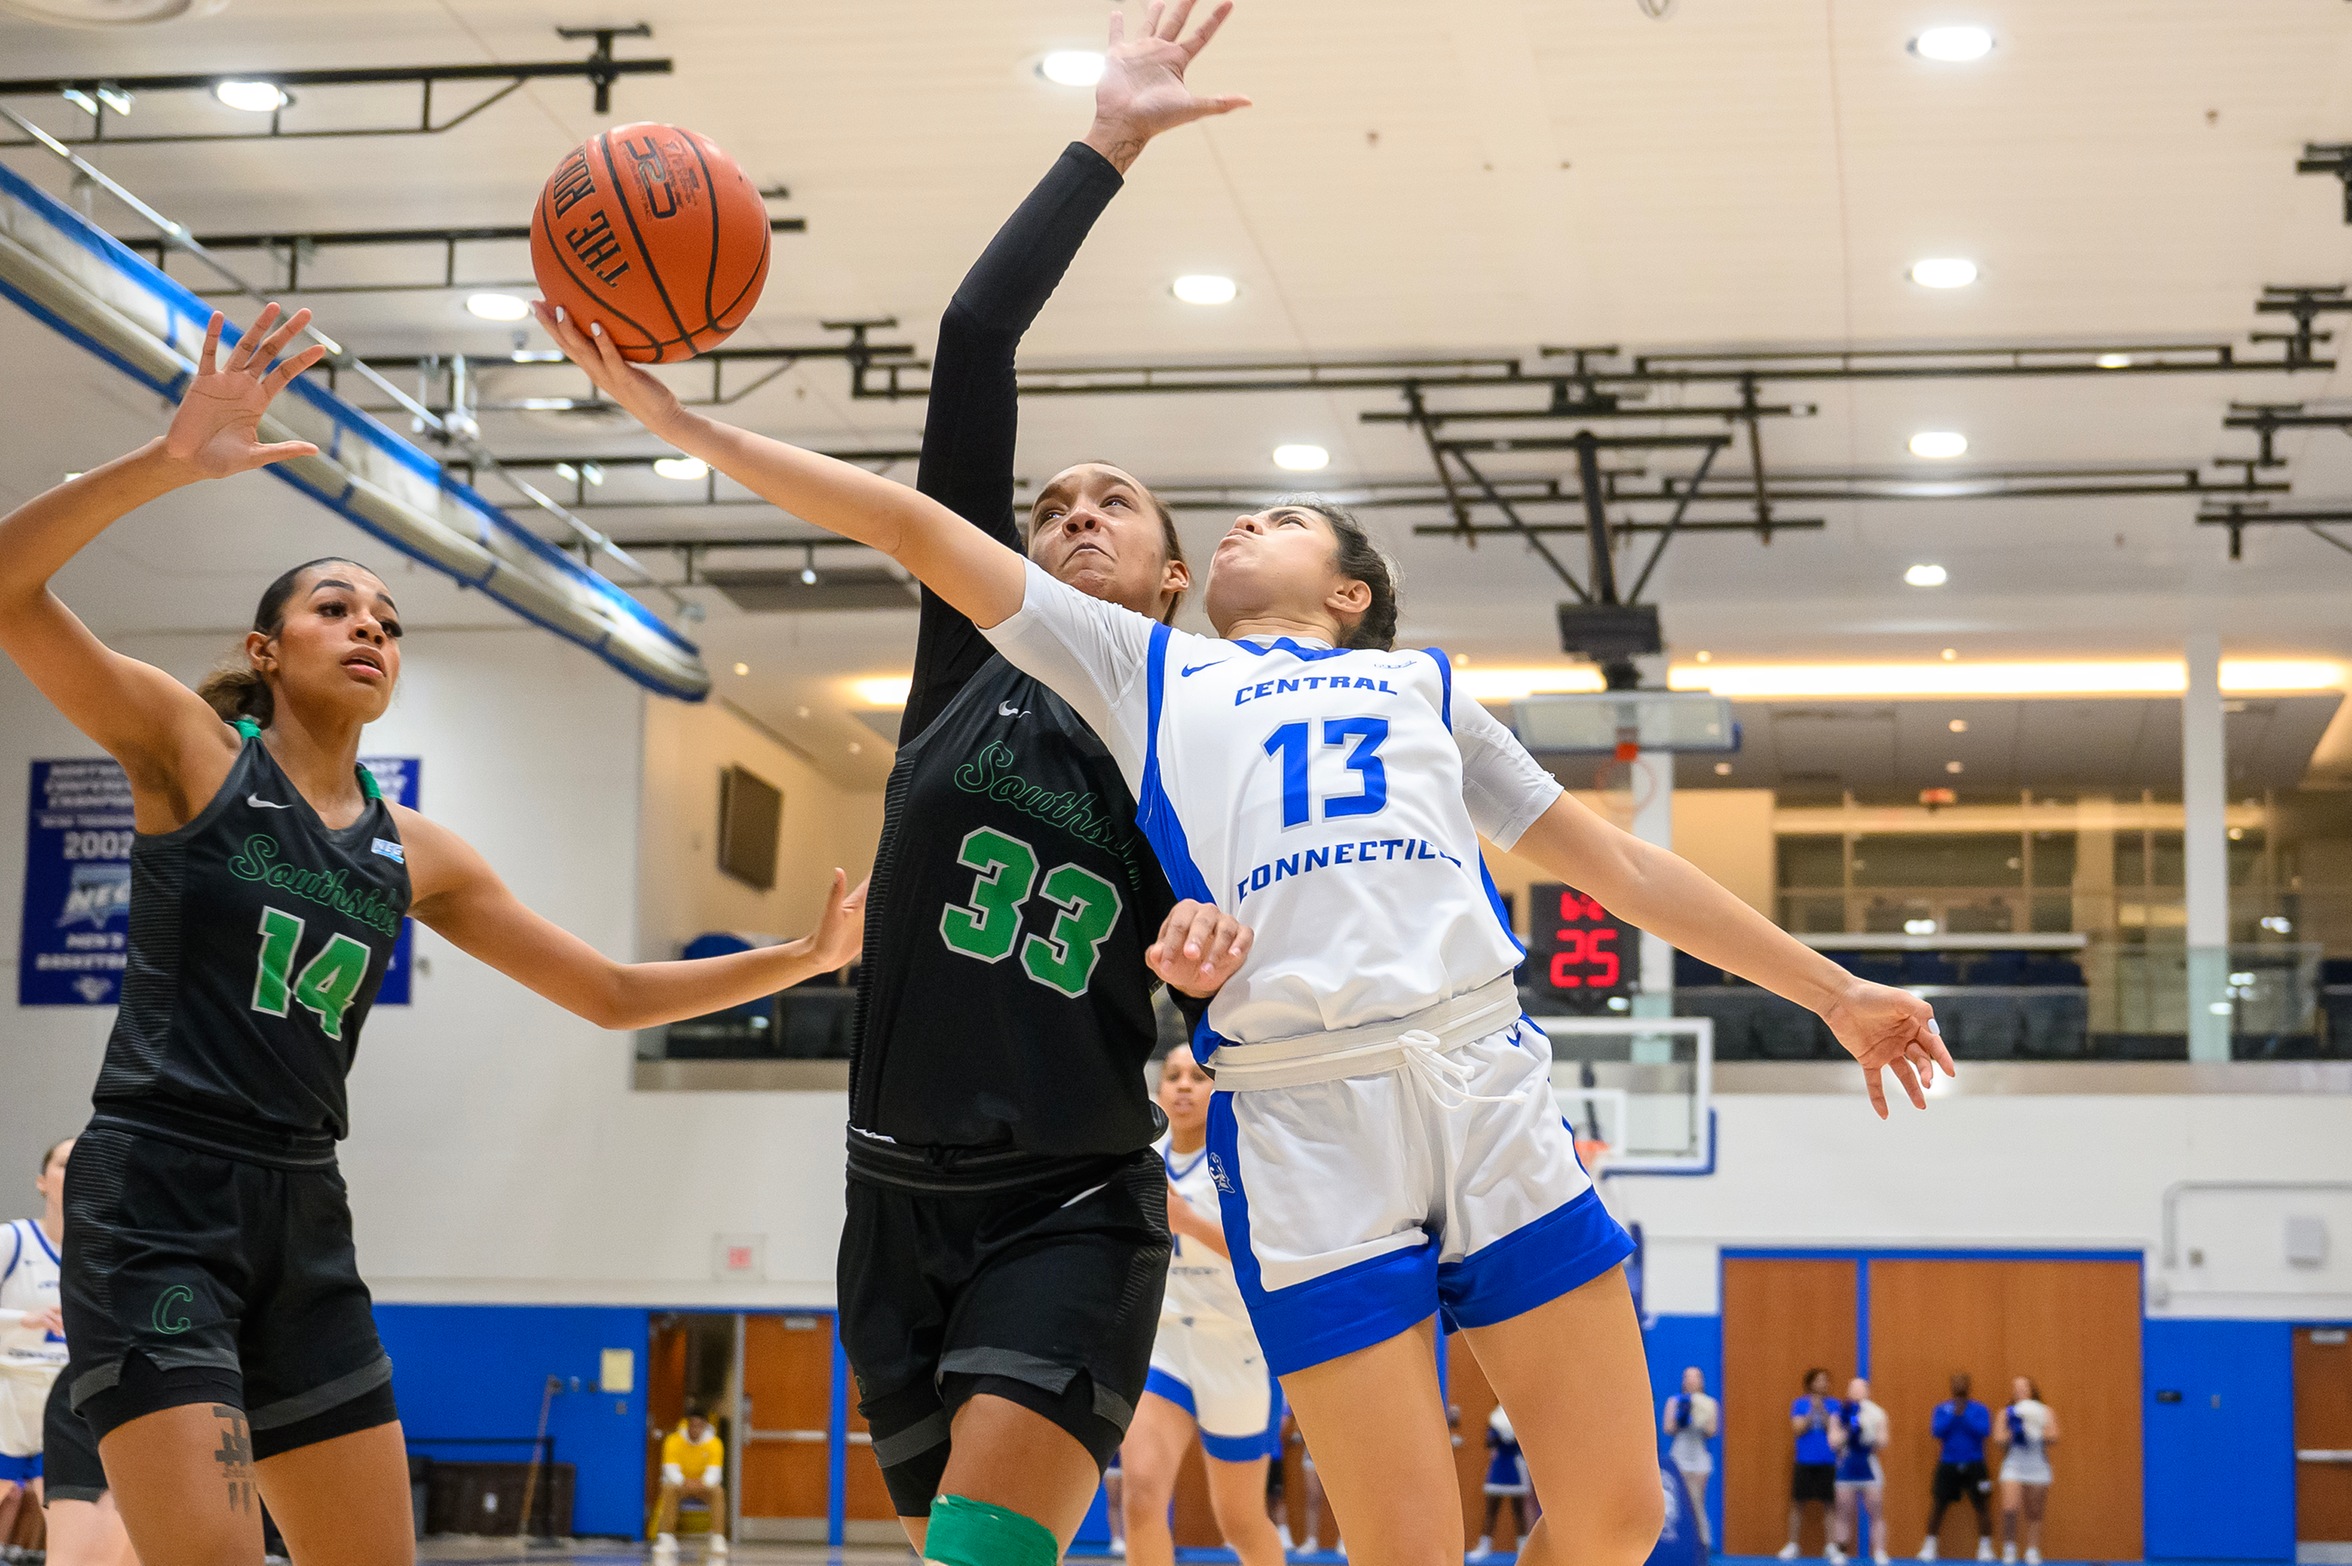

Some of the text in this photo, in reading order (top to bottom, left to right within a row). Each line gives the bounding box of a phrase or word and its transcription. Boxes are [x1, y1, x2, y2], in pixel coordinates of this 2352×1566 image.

[553, 143, 596, 219] ROC
[565, 209, 630, 288] THE
[1234, 676, 1398, 707] CENTRAL
[1260, 713, 1391, 833] 13
[1236, 838, 1462, 905] CONNECTIC
[939, 825, 1123, 999] 33
[250, 905, 371, 1041] 14
[1550, 928, 1620, 988] 25
[152, 1285, 193, 1335] C
